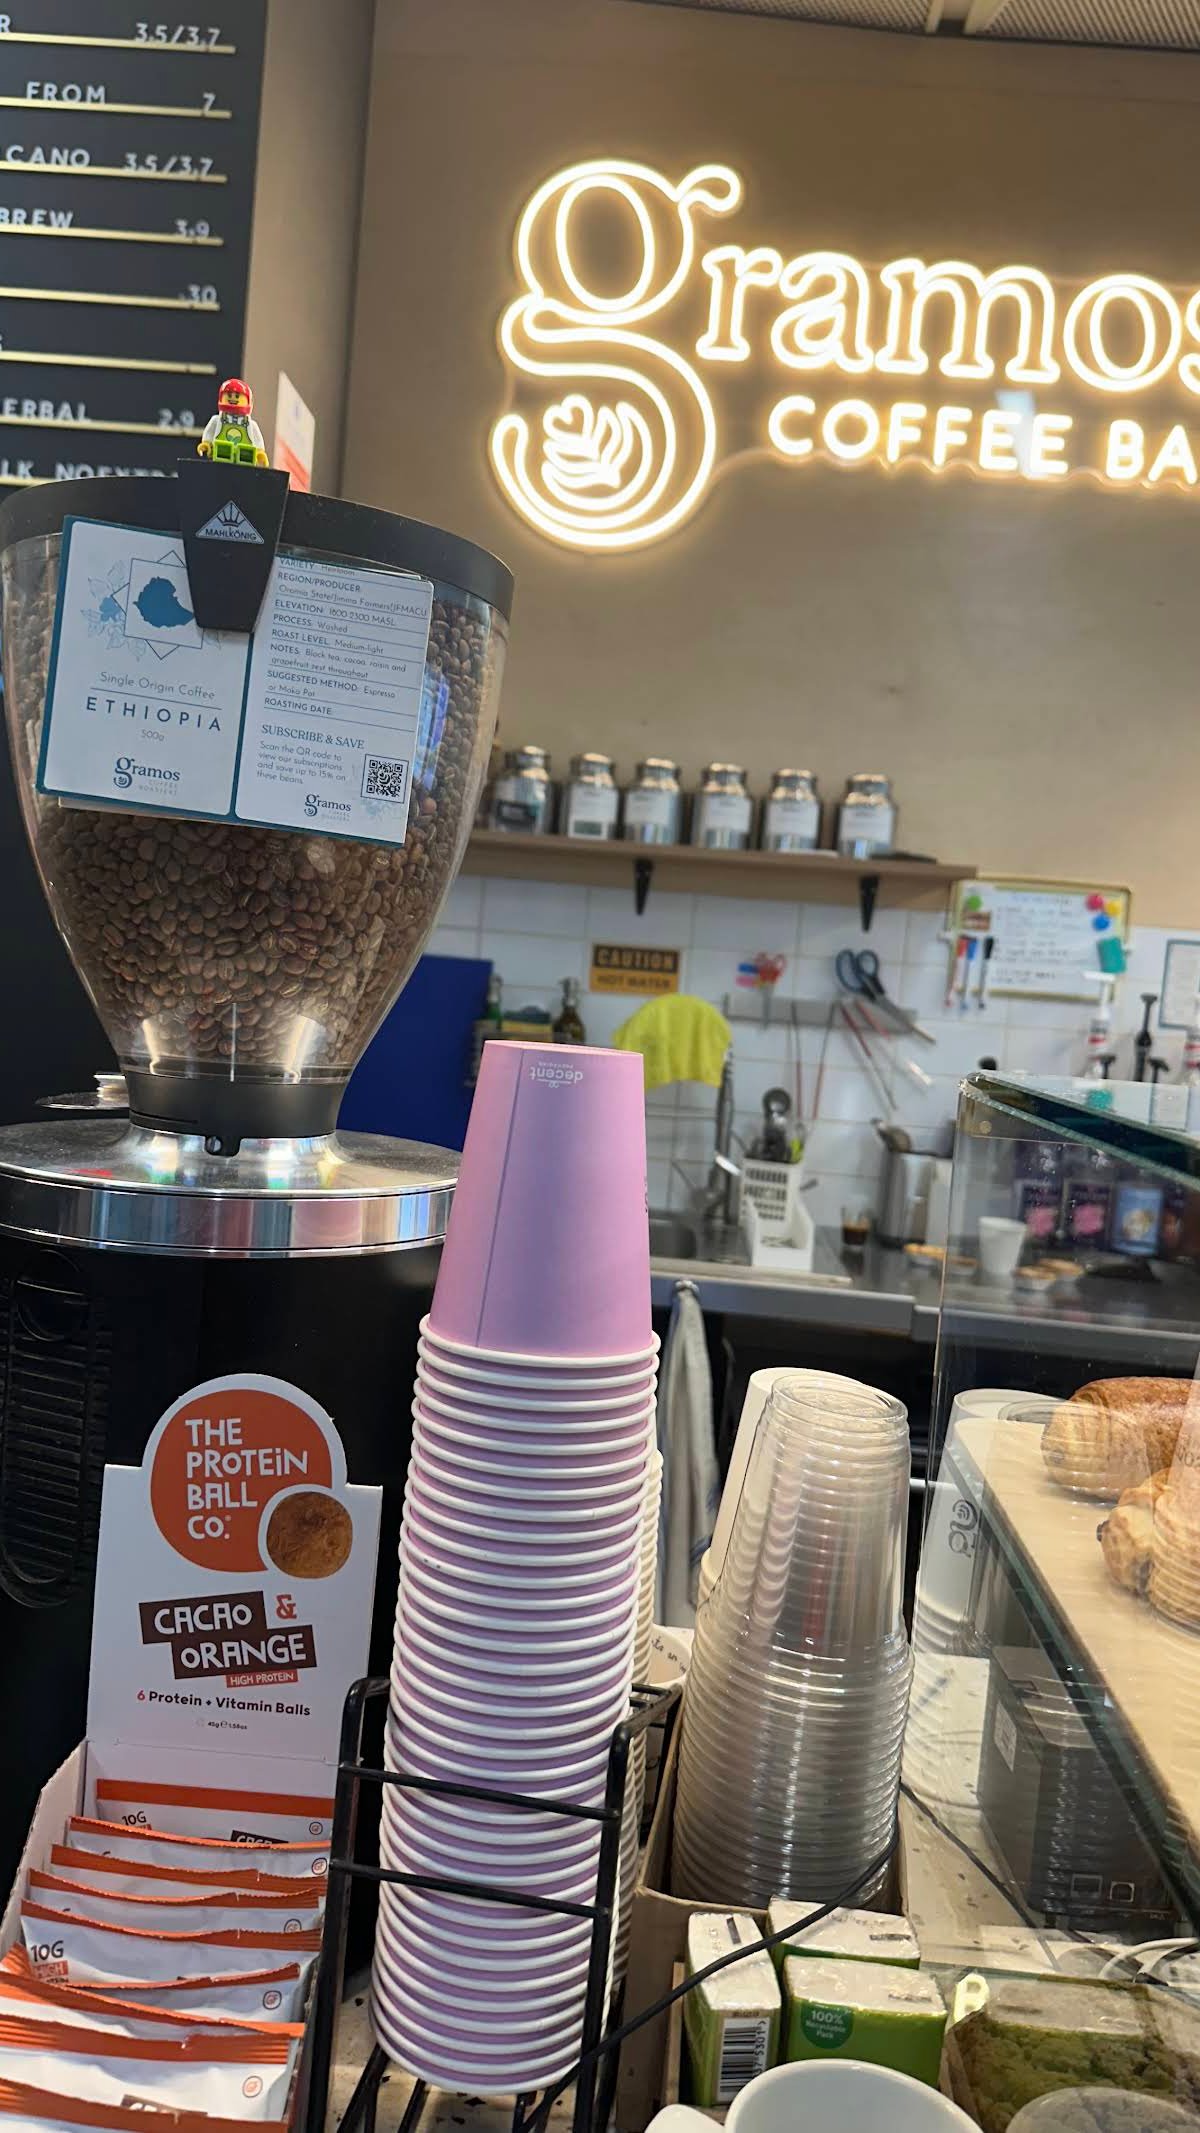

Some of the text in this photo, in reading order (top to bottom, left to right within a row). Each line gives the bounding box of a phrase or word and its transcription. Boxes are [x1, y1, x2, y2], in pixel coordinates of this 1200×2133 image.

[135, 22, 221, 47] 3.5/3.7
[26, 82, 216, 114] FROM 7
[490, 159, 1200, 547] gramo
[768, 395, 1073, 477] COFFEE
[205, 528, 258, 540] MAHLKÖNIG
[271, 628, 299, 641] ROAST
[317, 620, 348, 634] Washed
[267, 670, 318, 685] SUGGESTED
[391, 663, 407, 673] and
[100, 671, 216, 700] Single Origin Coffee
[86, 696, 221, 731] ETHIOPIA
[264, 696, 308, 711] ROASTING
[262, 724, 365, 750] SUBSCRIBE & SAVE
[259, 752, 276, 761] view
[294, 757, 343, 772] subscriptions
[260, 741, 342, 762] Scan the QR code to
[113, 757, 181, 789] gramos
[257, 761, 274, 770] and
[276, 764, 293, 773] save
[257, 769, 278, 780] these
[304, 794, 352, 817] gramos
[598, 948, 674, 970] CAUTION
[529, 1066, 584, 1084] decent
[185, 1418, 243, 1447] THE
[187, 1482, 258, 1511] BALL
[154, 1594, 297, 1635] CACAO &
[181, 1633, 306, 1669] ORANGE
[230, 1673, 294, 1686] HIGH PROTEIN
[136, 1690, 146, 1701] 6
[149, 1691, 202, 1706] Protein
[216, 1697, 272, 1713] Vitamin
[276, 1702, 311, 1716] Balls
[121, 1810, 147, 1826] 10G
[30, 1940, 64, 1962] 10G
[811, 2010, 844, 2025] 100%
